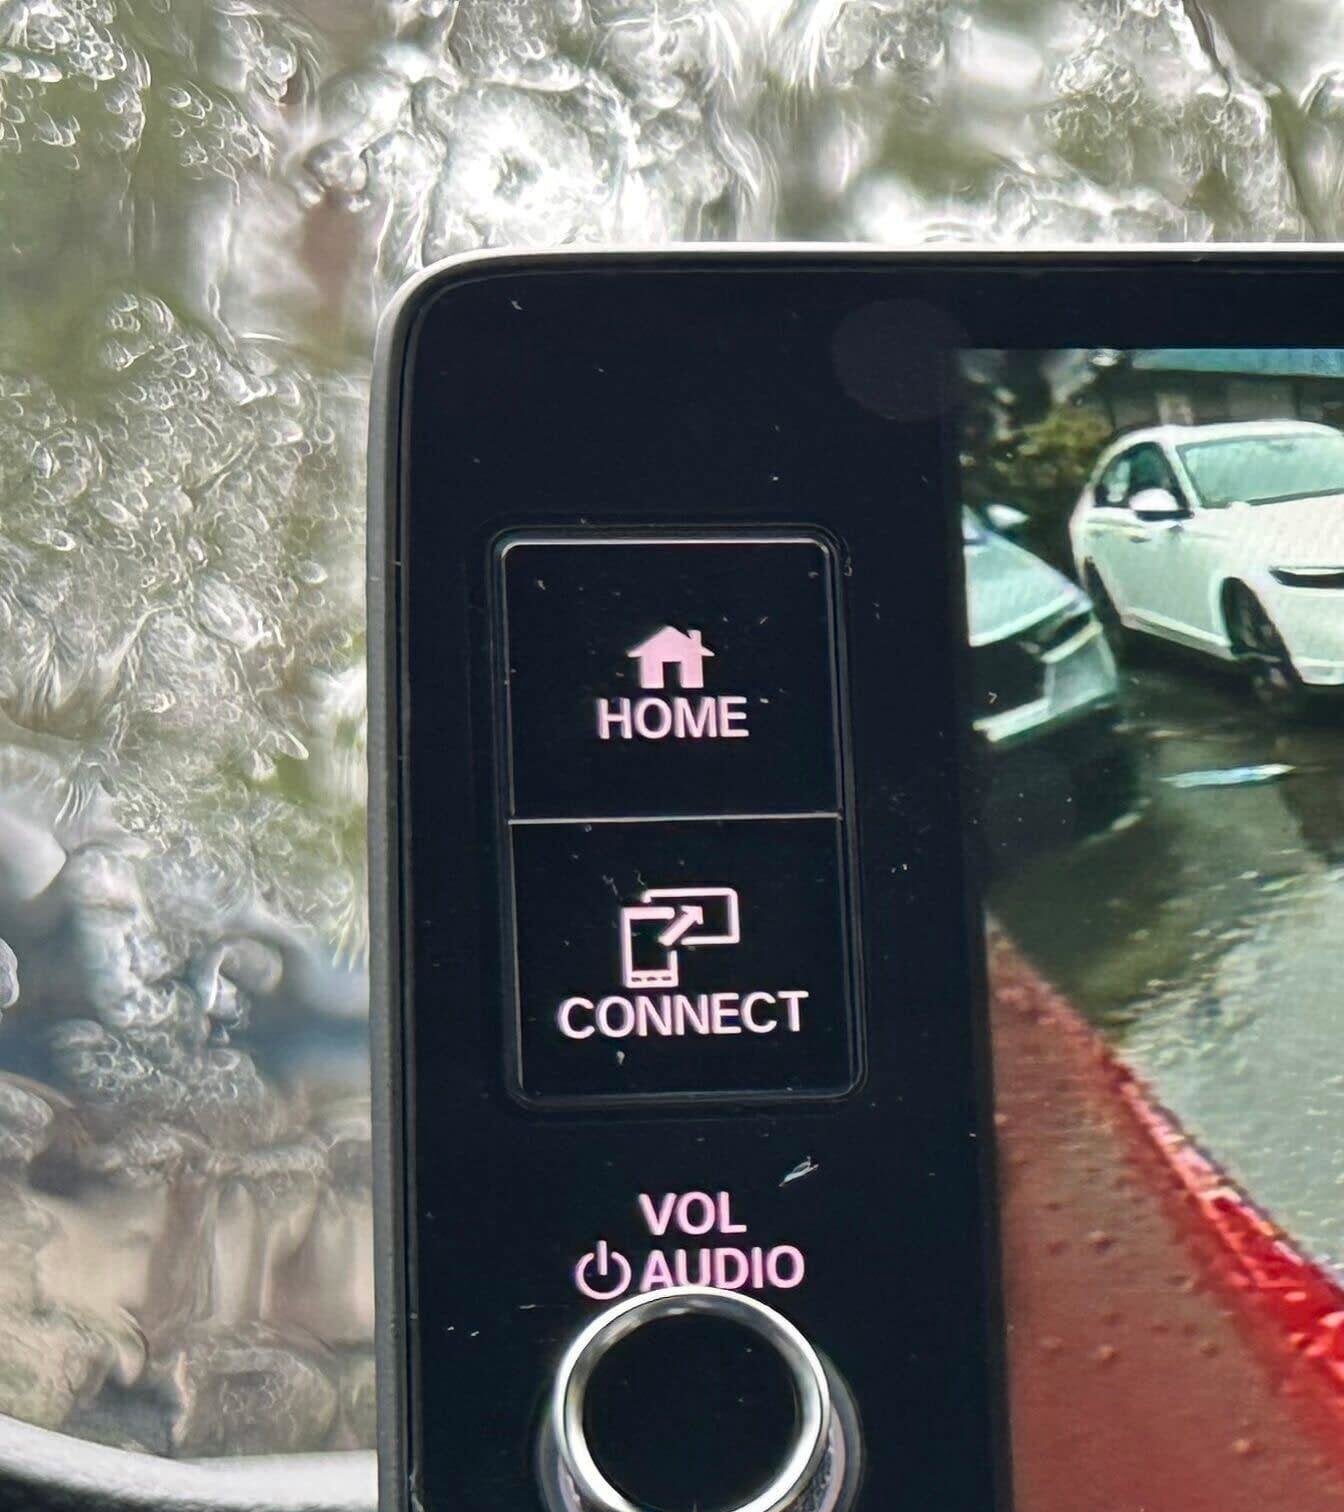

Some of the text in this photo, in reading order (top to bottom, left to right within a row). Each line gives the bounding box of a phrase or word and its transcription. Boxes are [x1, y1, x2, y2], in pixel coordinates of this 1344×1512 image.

[598, 696, 749, 739] HOME
[558, 990, 809, 1039] CONNECT
[638, 1191, 747, 1236] VOL
[640, 1245, 805, 1291] AUDIO
